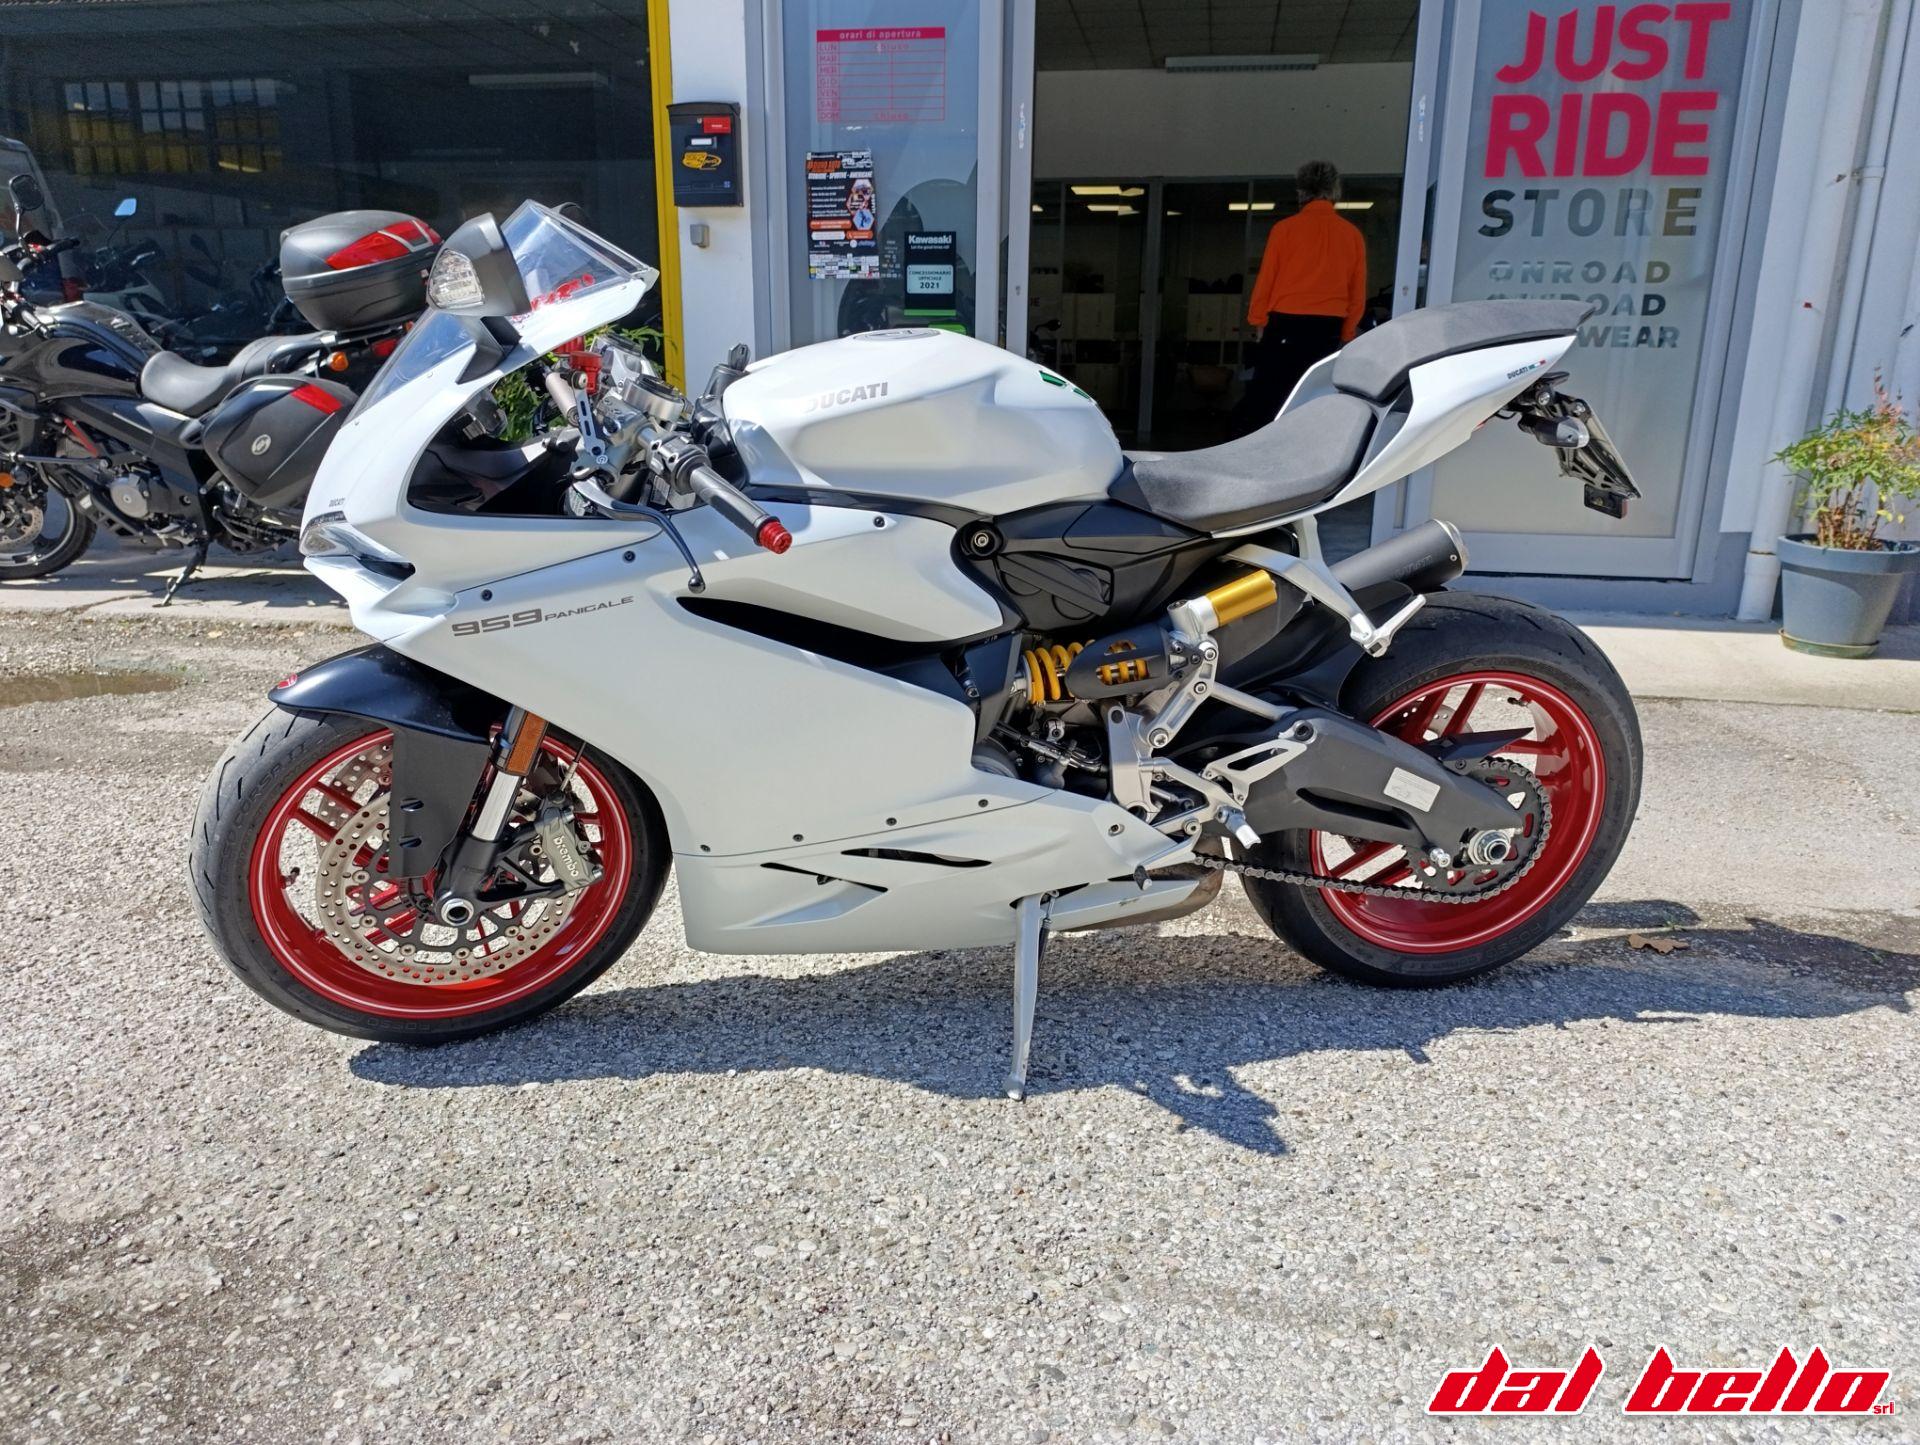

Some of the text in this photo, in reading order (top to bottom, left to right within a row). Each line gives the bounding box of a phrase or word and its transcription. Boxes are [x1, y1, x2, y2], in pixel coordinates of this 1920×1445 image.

[839, 29, 922, 40] orari di apertura
[1495, 3, 1731, 84] JUST
[1484, 91, 1719, 178] RIDE
[1477, 188, 1702, 237] STORE
[908, 235, 952, 245] Kawasaki
[1489, 260, 1671, 284] ONROAD
[1507, 366, 1528, 379] DUCATI
[452, 596, 635, 637] 959 PANIGALE
[553, 835, 579, 877] brembo
